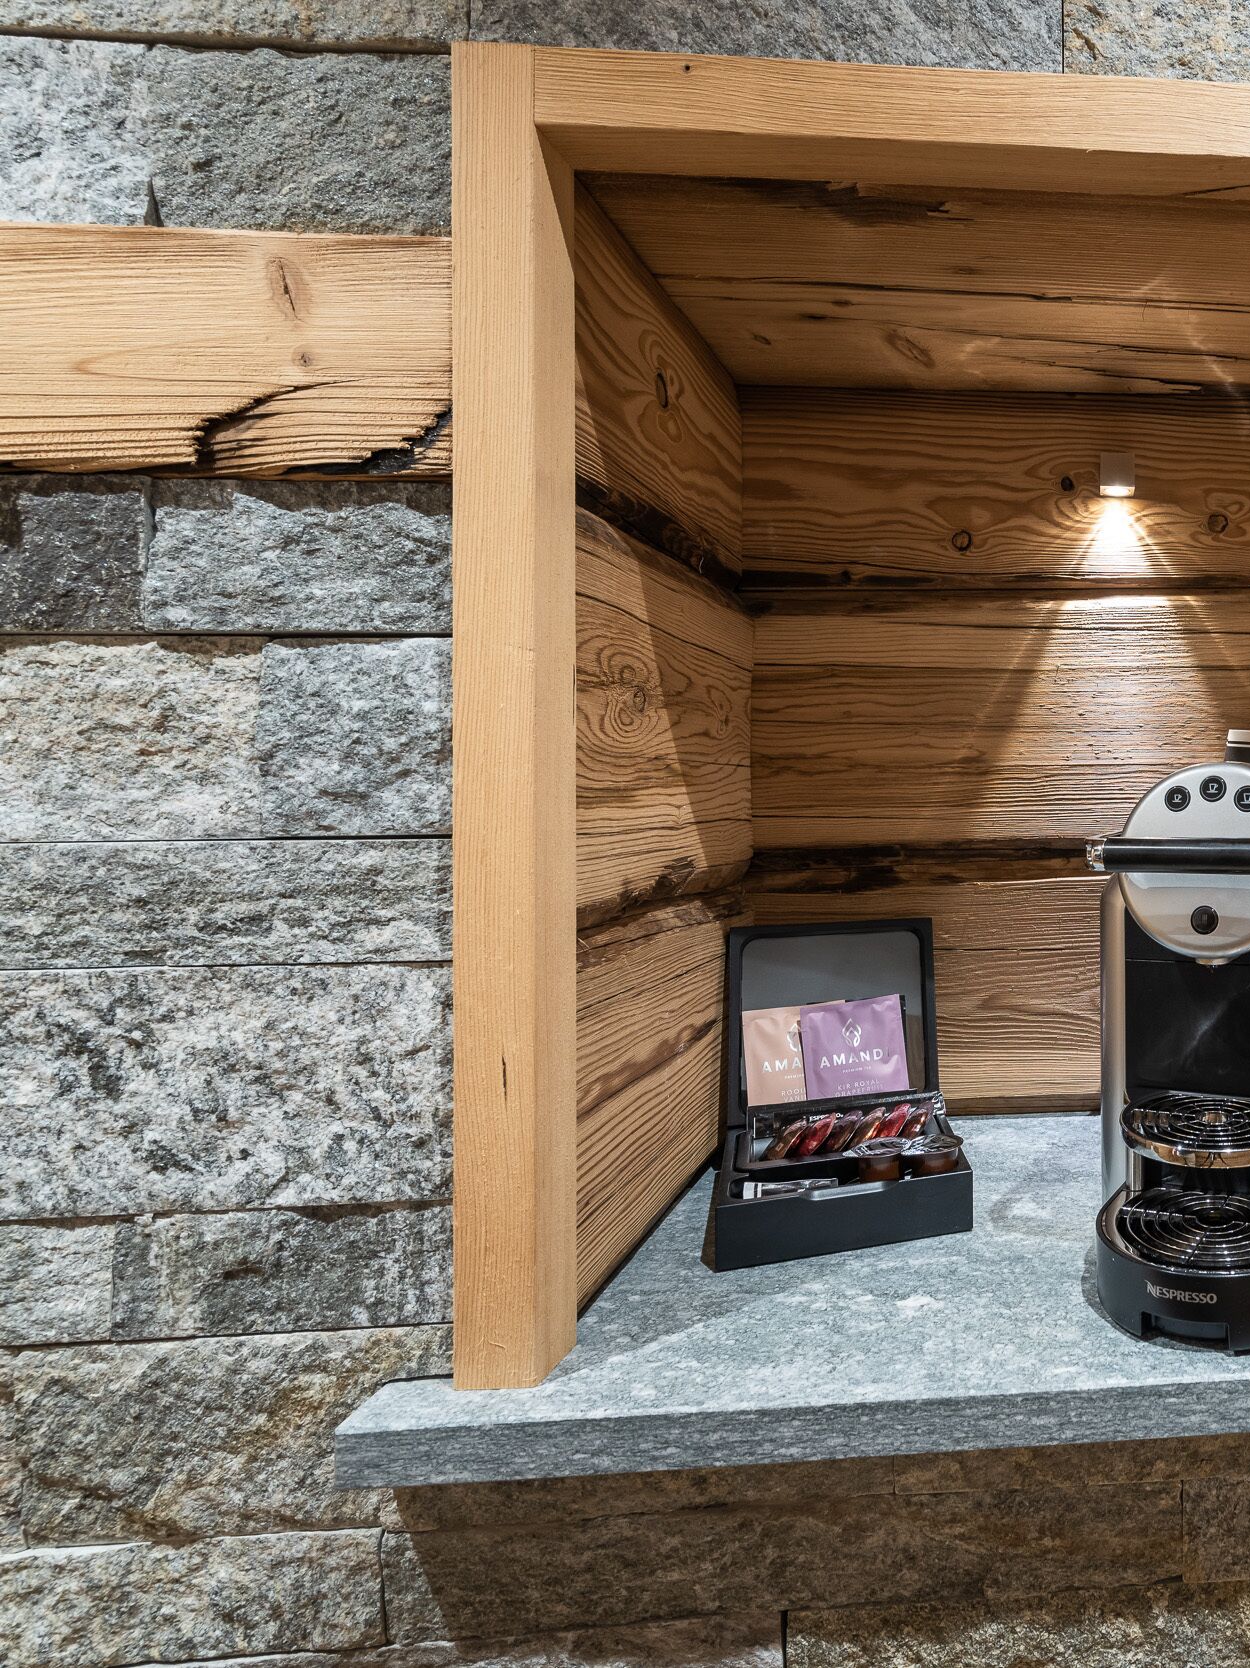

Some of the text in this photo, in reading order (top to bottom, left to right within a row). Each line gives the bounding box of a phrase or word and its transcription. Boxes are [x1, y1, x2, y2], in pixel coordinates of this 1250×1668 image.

[820, 1048, 883, 1069] AMAND
[838, 1079, 880, 1091] KIR ROYAL
[1144, 1279, 1218, 1304] NESPRESSO
